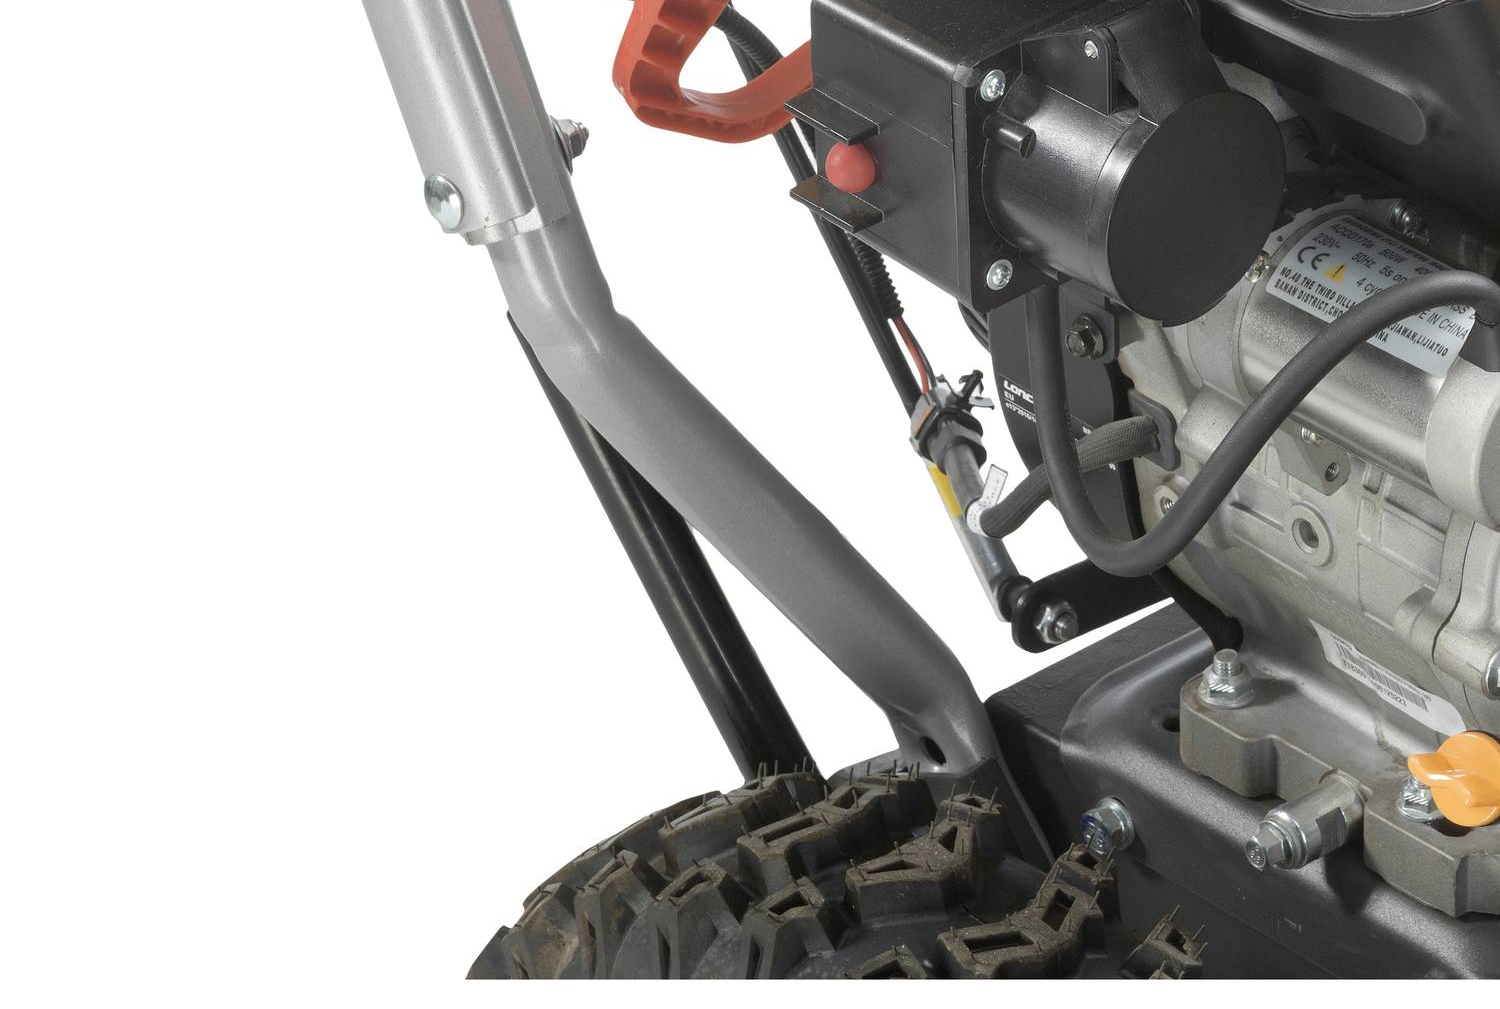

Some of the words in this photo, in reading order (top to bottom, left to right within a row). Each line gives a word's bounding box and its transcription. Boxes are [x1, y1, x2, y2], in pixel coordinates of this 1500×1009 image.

[1351, 251, 1377, 269] 50Hz
[1378, 265, 1394, 278] 5s
[1274, 278, 1298, 298] BANAN
[1300, 276, 1316, 290] THE
[1315, 284, 1337, 301] THIRD
[1356, 277, 1367, 287] 4
[1426, 312, 1439, 326] IN
[1438, 318, 1469, 340] CHINA
